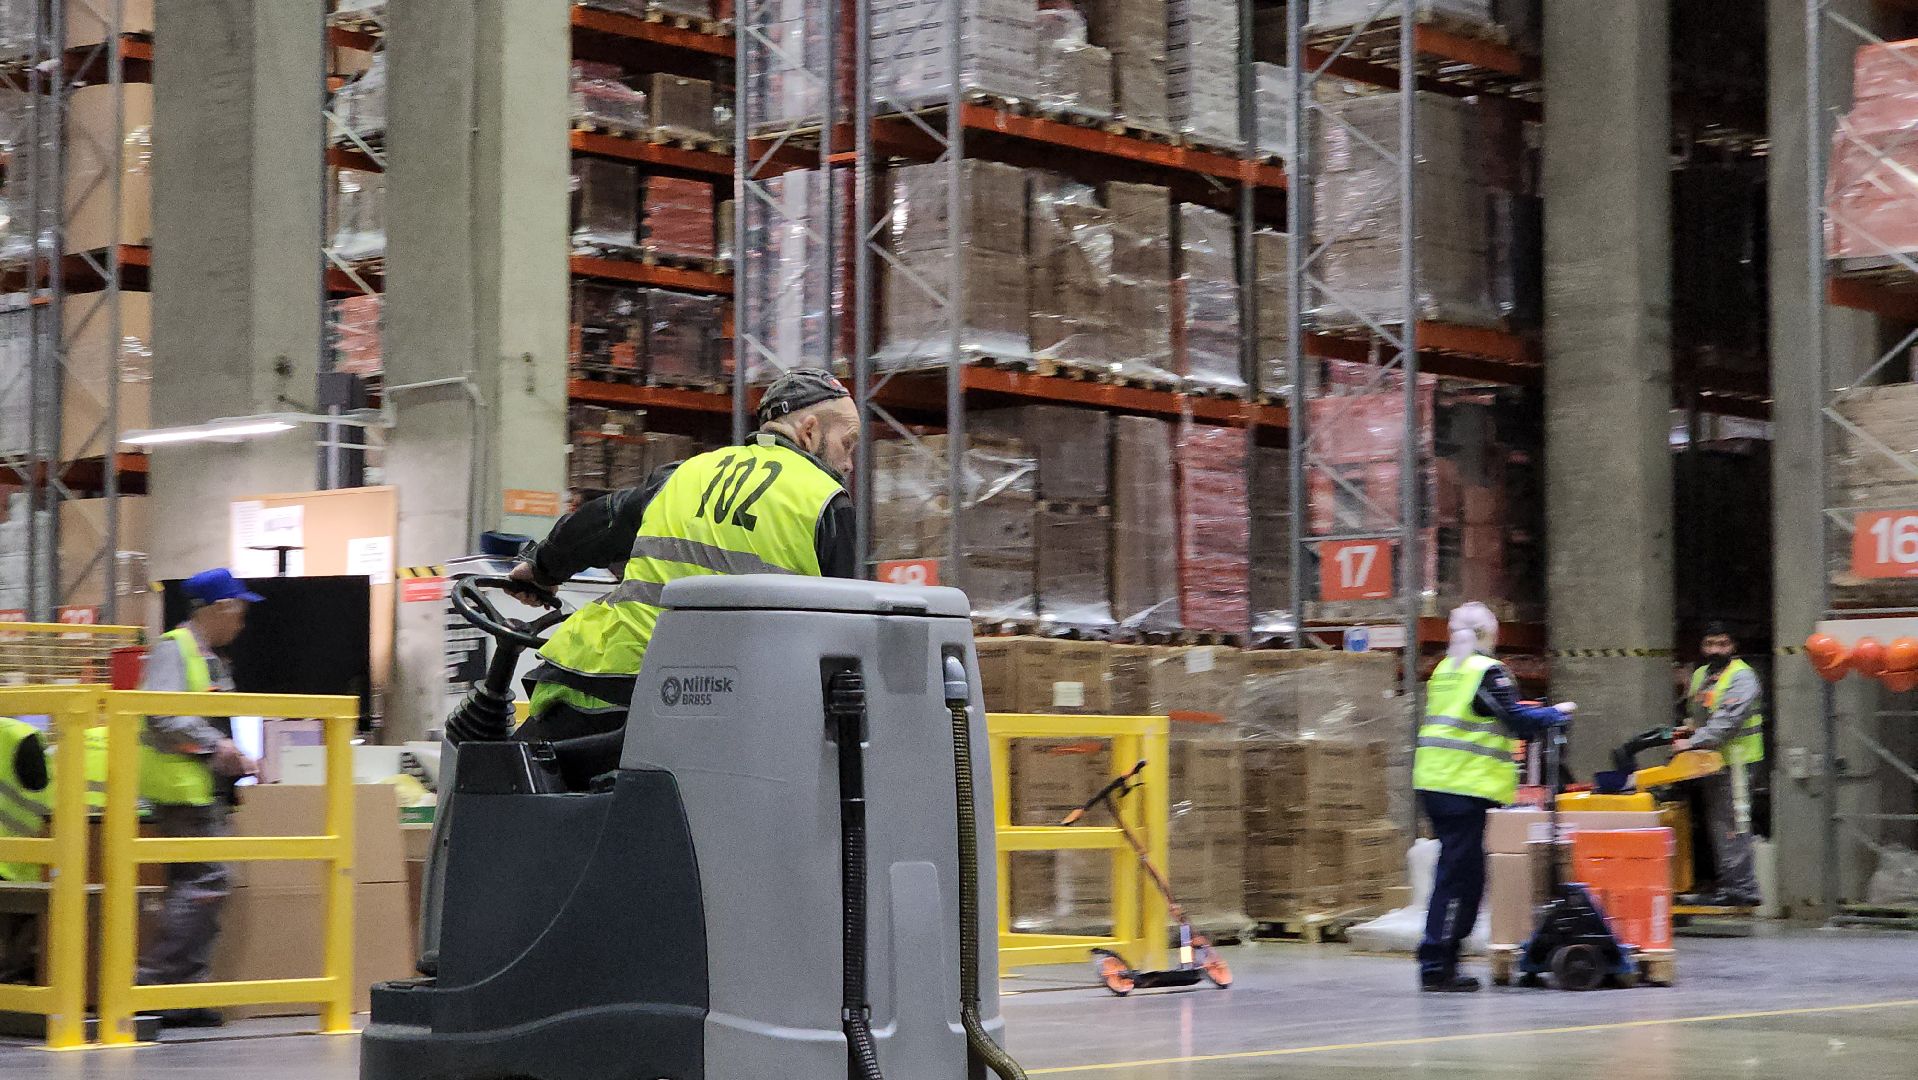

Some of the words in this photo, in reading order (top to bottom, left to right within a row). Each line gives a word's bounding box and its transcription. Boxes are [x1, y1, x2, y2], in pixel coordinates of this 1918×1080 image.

[695, 454, 783, 532] 102
[1870, 515, 1918, 564] 16
[1335, 545, 1378, 588] 17
[682, 693, 713, 706] BR855
[683, 676, 734, 693] Nilfisk
